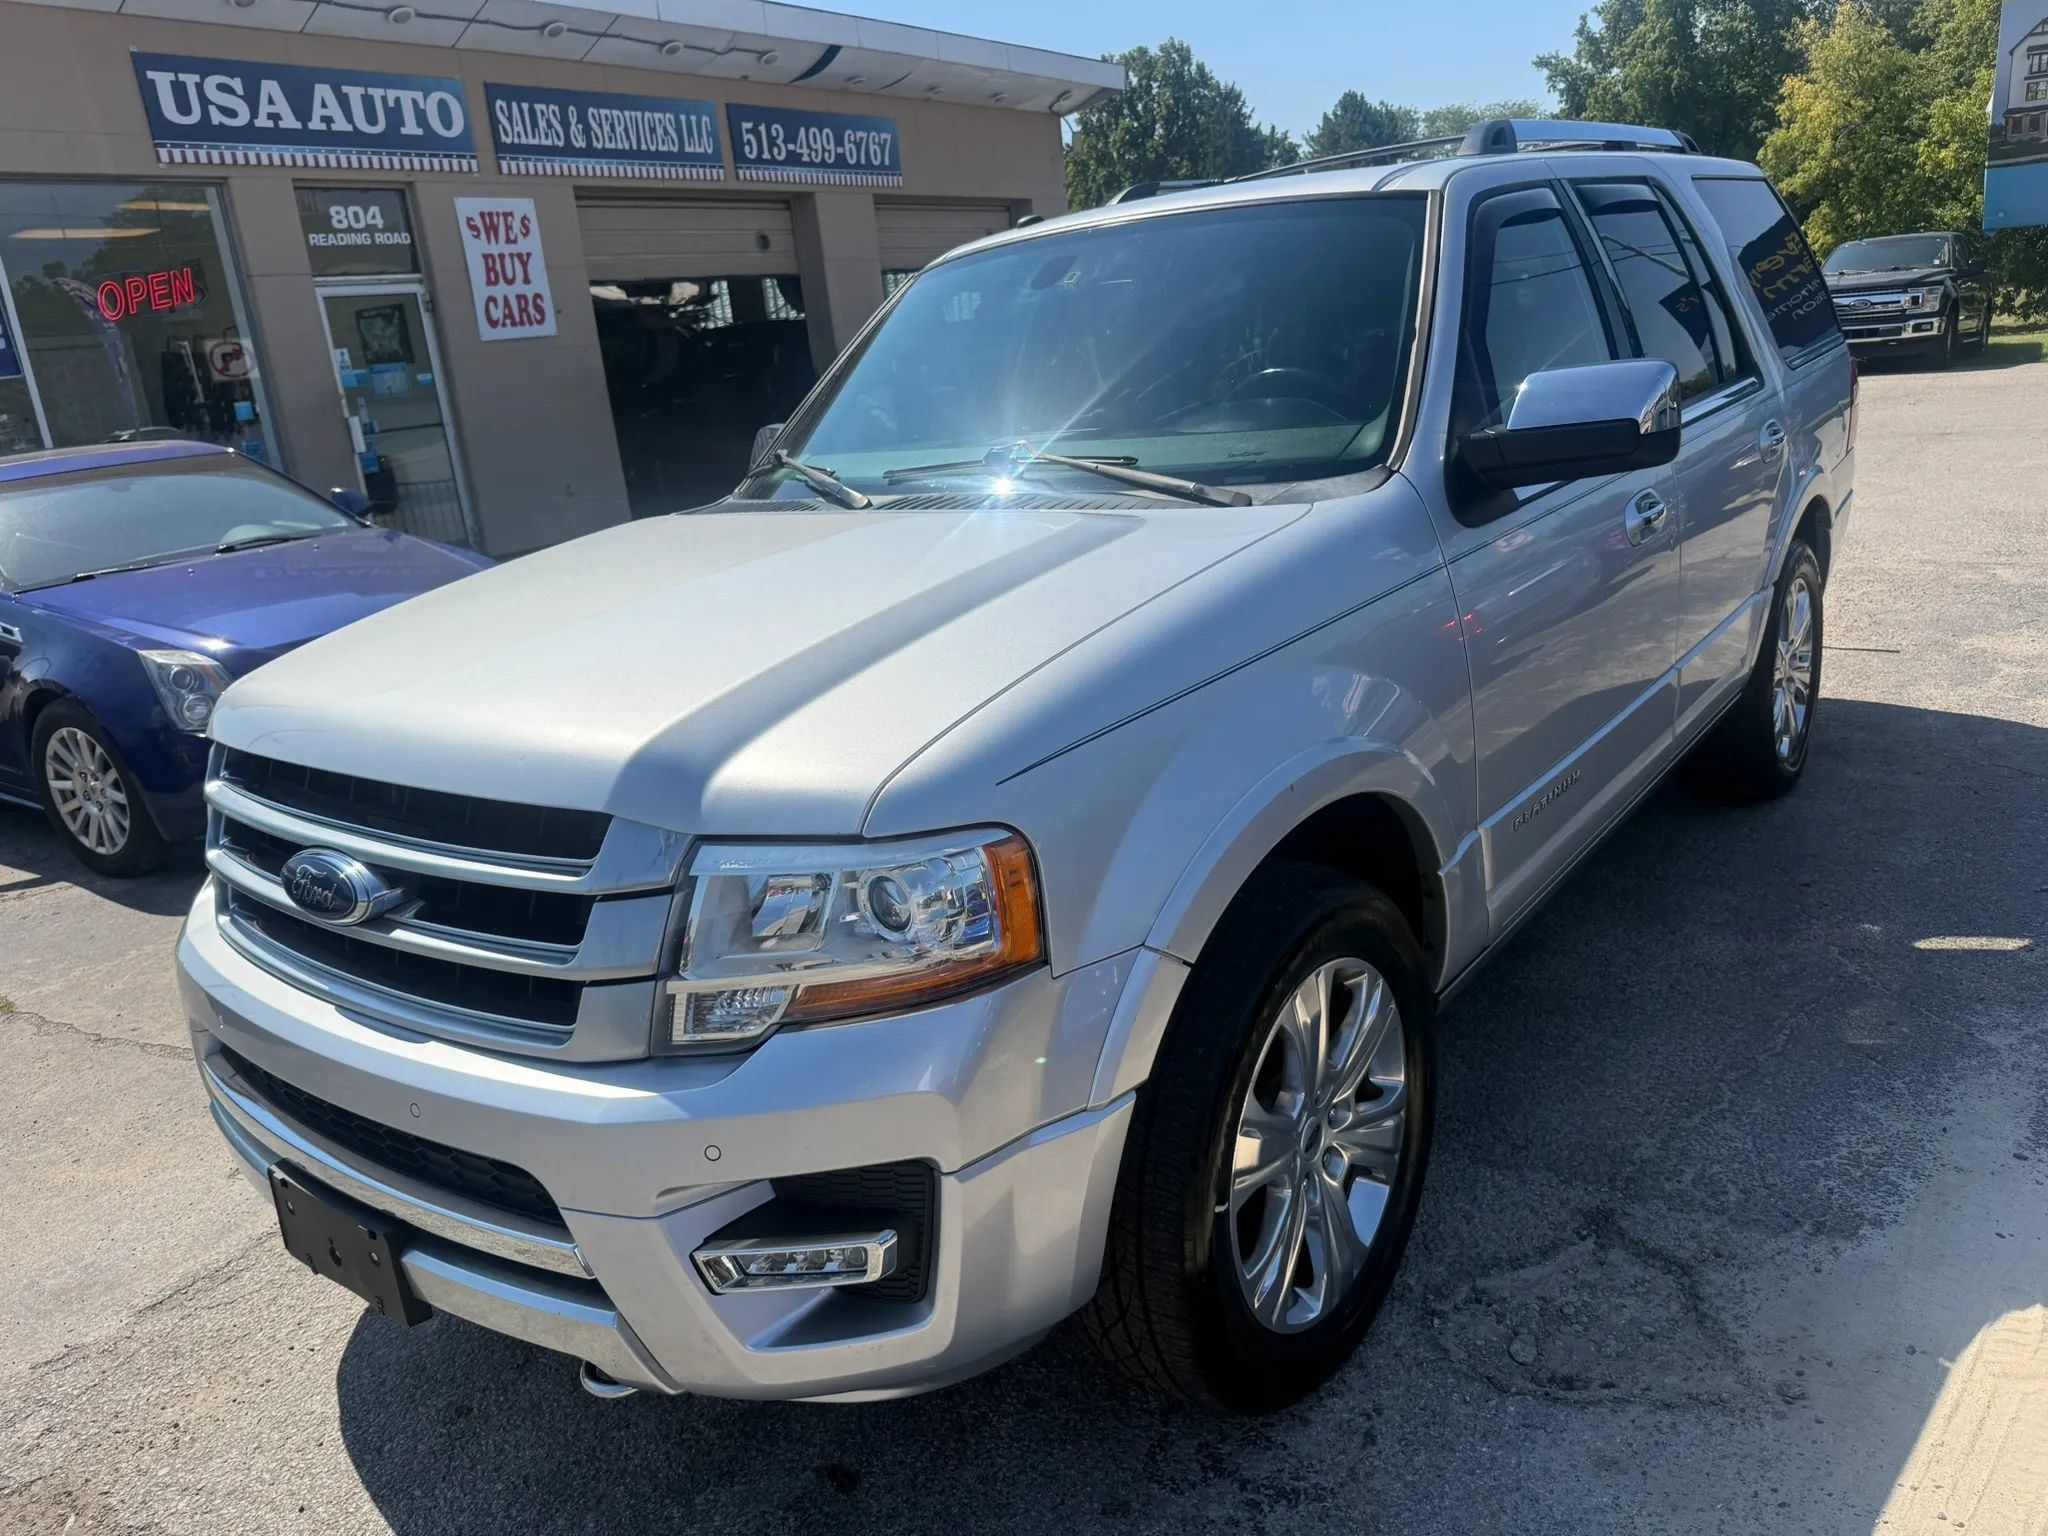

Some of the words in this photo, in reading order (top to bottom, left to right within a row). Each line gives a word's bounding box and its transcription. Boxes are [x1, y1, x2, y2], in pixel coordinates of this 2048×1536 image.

[146, 70, 302, 130] USA
[308, 83, 465, 138] AUTO
[495, 98, 565, 147] SALES
[568, 105, 587, 149] &
[588, 108, 679, 153] SERVICES
[679, 114, 714, 155] LLC
[740, 121, 892, 166] 513-499-6767
[308, 233, 372, 246] READING
[374, 232, 411, 245] ROAD
[329, 205, 384, 229] 804
[481, 252, 532, 287] BUY
[97, 267, 195, 321] OPEN
[484, 292, 547, 329] CARS
[291, 864, 338, 910] Ford
